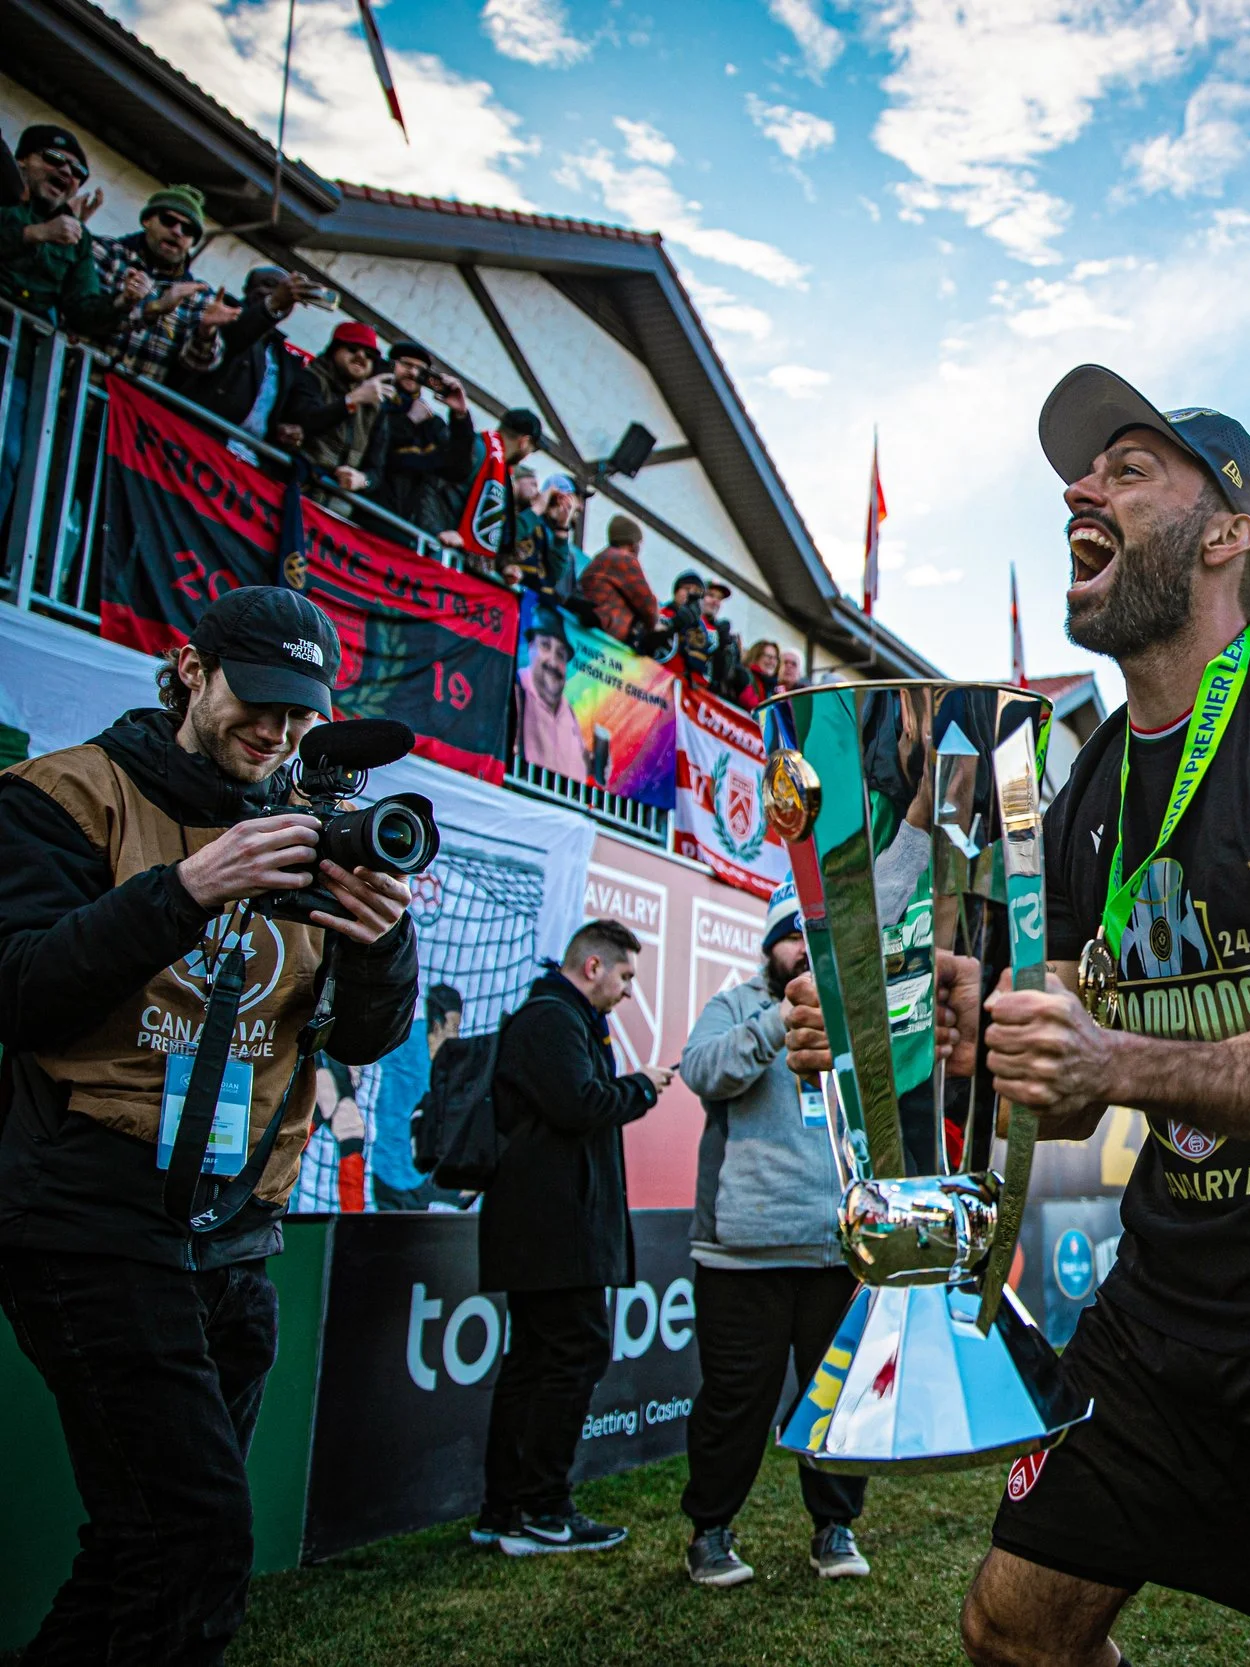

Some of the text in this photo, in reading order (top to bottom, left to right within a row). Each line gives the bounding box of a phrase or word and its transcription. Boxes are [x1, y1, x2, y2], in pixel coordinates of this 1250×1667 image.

[283, 641, 314, 656] NORTH
[290, 650, 312, 662] FACE
[298, 638, 314, 649] THE
[432, 661, 474, 710] 19
[1184, 675, 1234, 773] PREMIER
[584, 880, 660, 927] AVALRY
[698, 915, 764, 956] CAVALR
[1218, 928, 1250, 958] 24
[137, 1031, 199, 1056] PREMIE
[221, 1082, 239, 1090] DIAN
[203, 1157, 218, 1165] TAFF
[1164, 1165, 1242, 1202] AVALRY
[582, 1395, 693, 1441] Betting Casino
